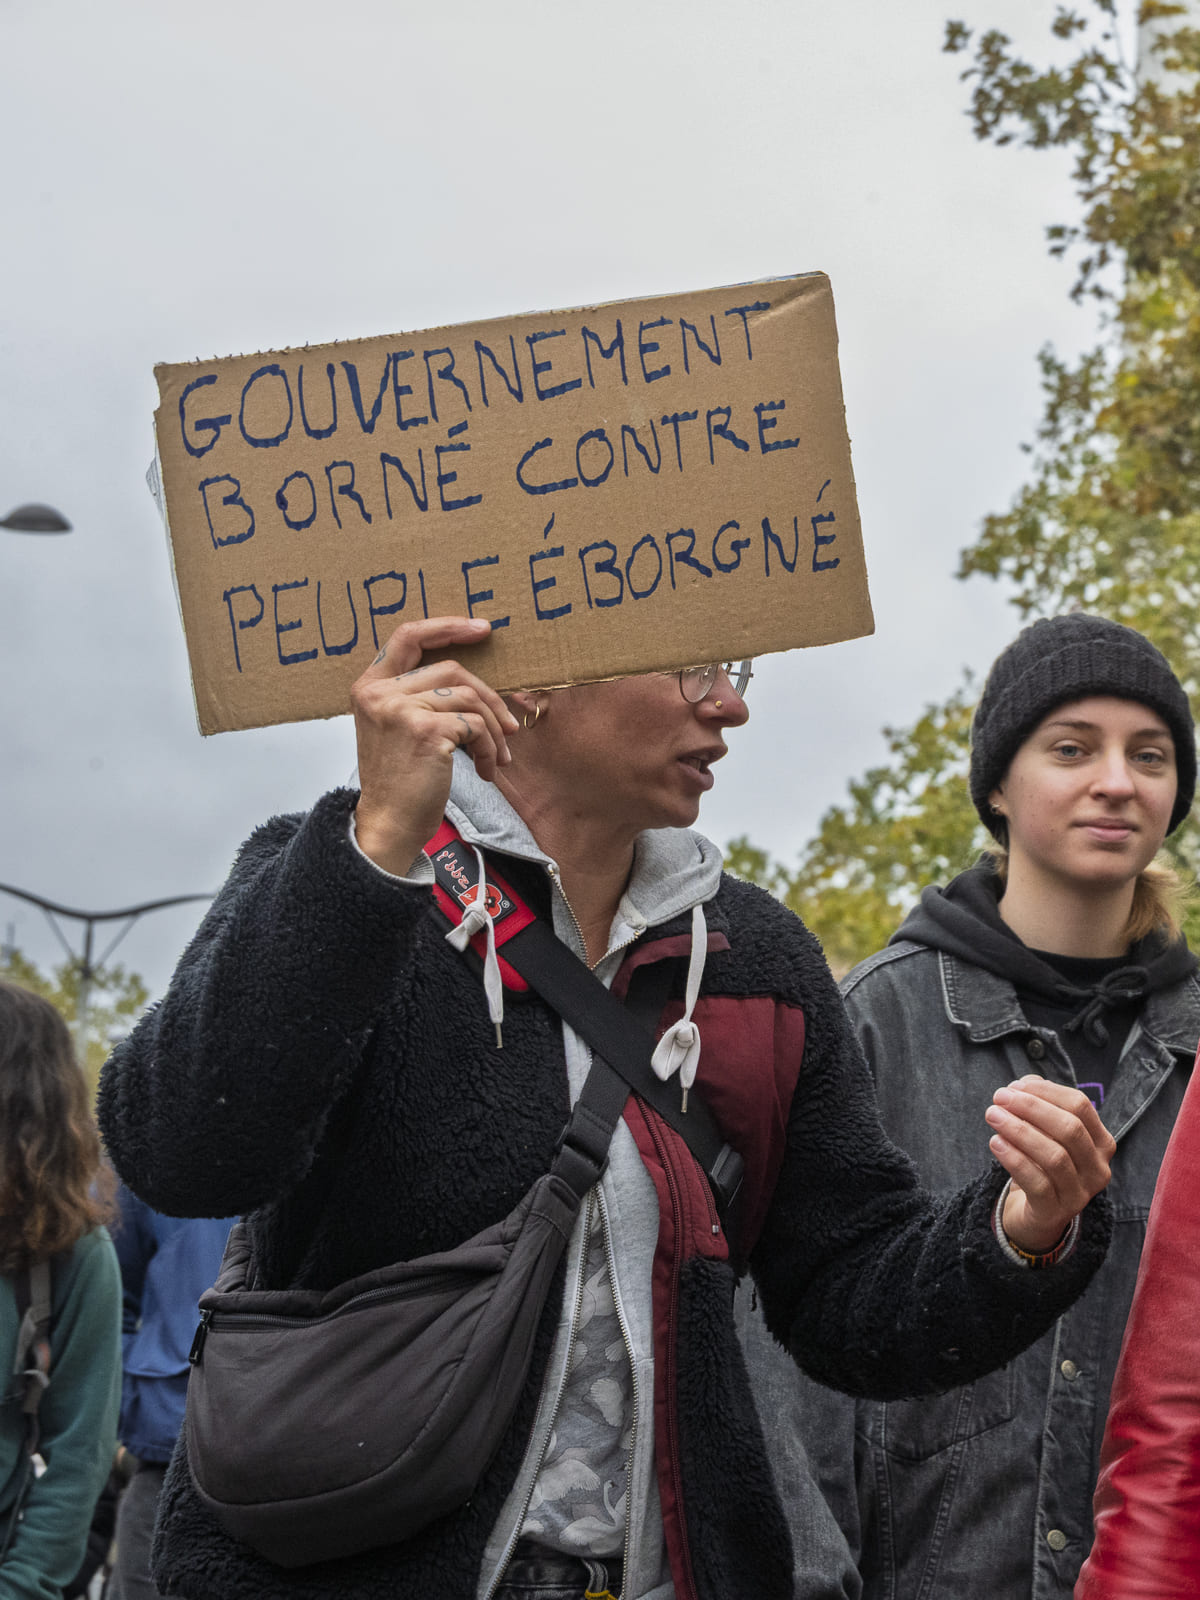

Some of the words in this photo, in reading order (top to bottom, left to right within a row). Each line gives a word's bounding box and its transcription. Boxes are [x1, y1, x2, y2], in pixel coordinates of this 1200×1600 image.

[178, 301, 771, 459] GOUVERNEMENT
[197, 420, 483, 550] BORNÉ
[516, 399, 801, 496] CONTRE
[529, 479, 842, 622] ÉBORGNÉ
